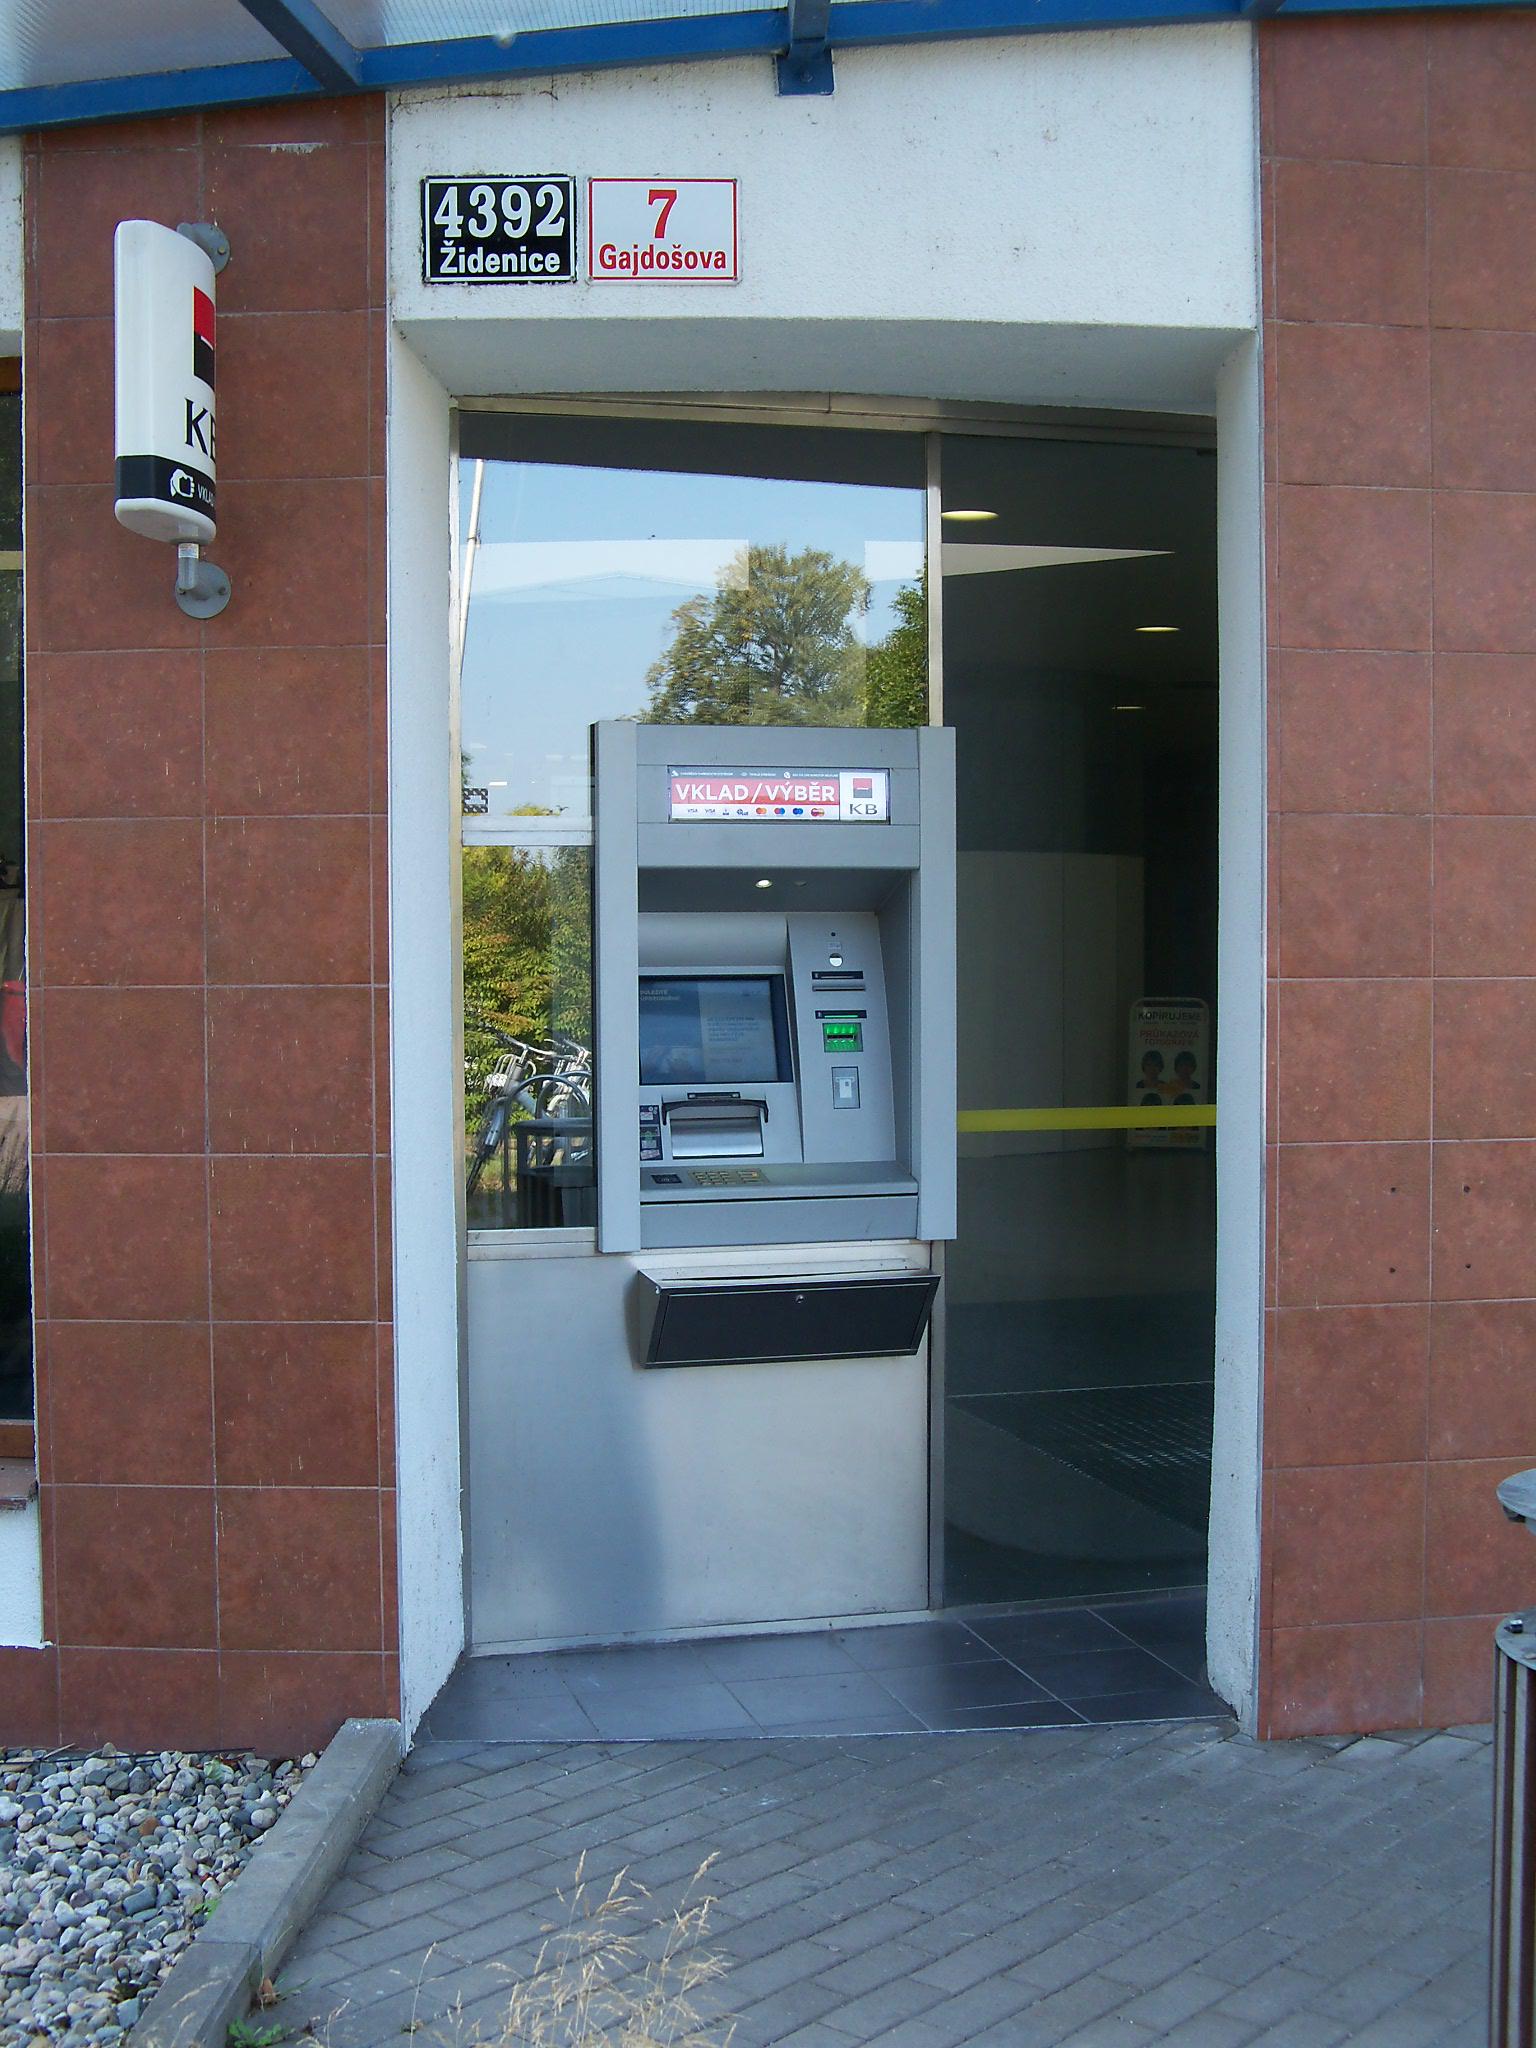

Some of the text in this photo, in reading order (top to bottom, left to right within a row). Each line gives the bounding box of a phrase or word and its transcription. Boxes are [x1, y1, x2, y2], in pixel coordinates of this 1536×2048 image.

[433, 184, 566, 239] 4392
[647, 189, 678, 239] 7
[439, 240, 561, 274] Židenice
[599, 243, 727, 276] Gajdošova
[849, 803, 878, 815] KB
